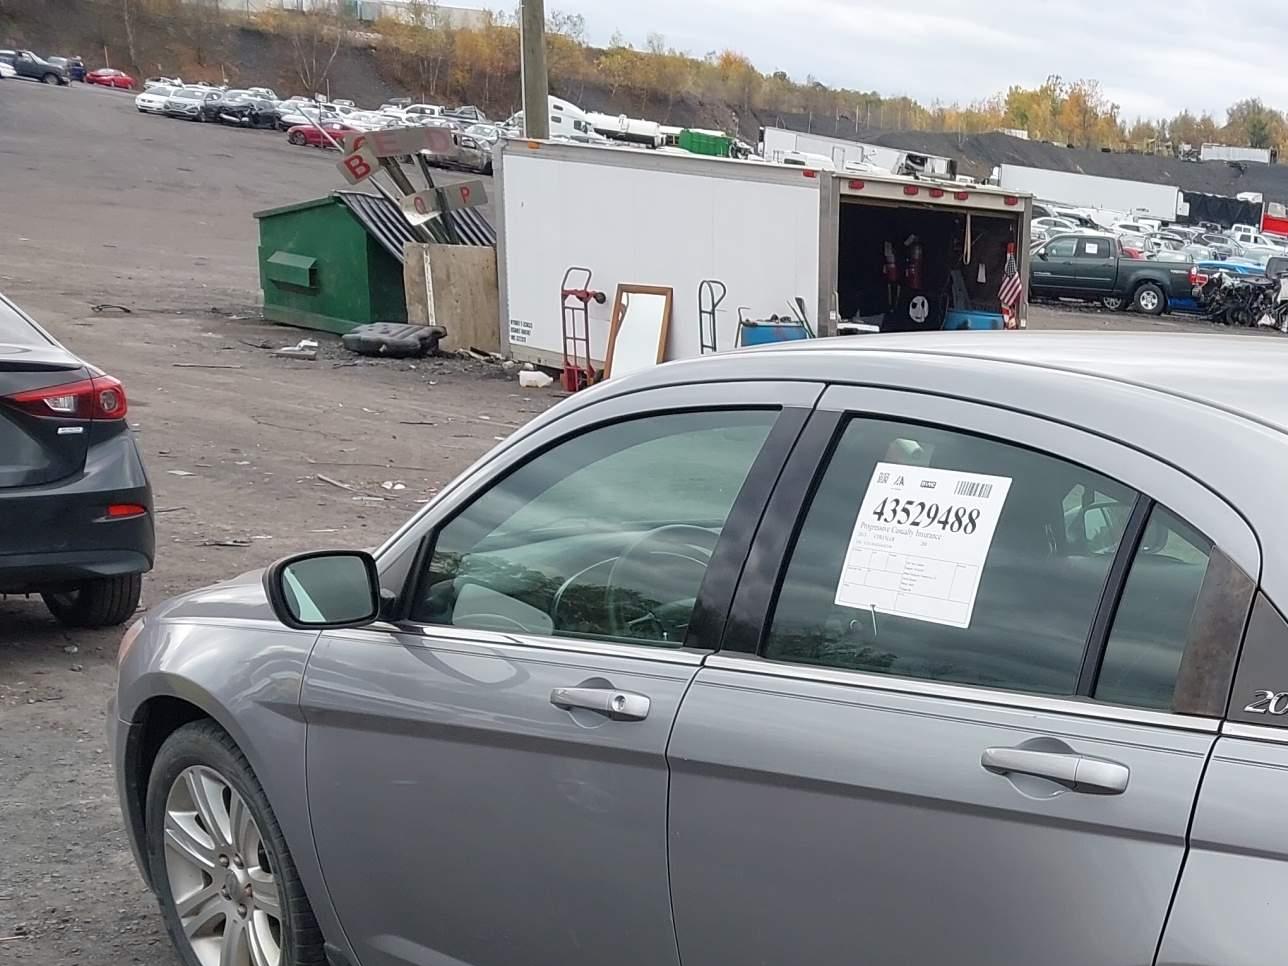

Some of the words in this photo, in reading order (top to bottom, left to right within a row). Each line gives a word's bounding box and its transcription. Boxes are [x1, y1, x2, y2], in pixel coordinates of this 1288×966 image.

[344, 155, 371, 180] B
[459, 186, 471, 204] P
[872, 496, 981, 535] 43529488
